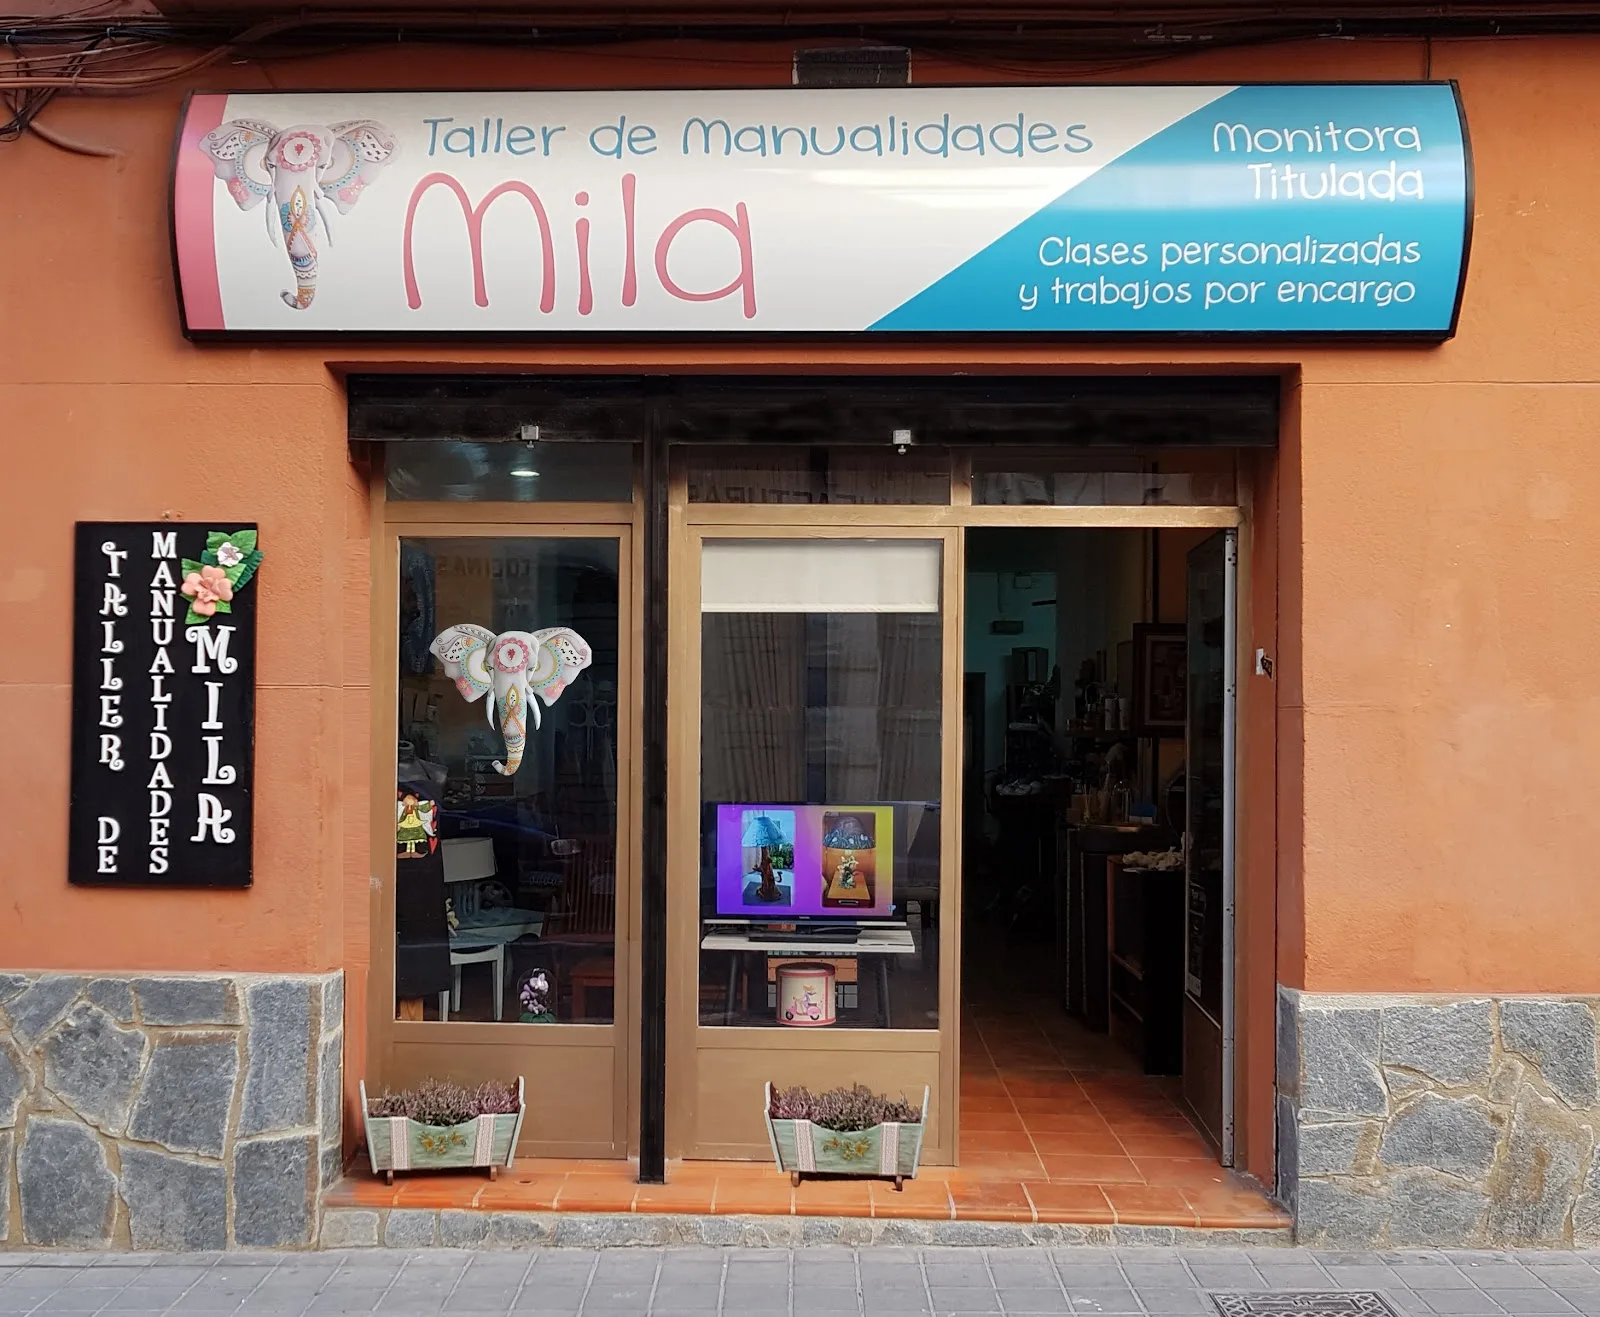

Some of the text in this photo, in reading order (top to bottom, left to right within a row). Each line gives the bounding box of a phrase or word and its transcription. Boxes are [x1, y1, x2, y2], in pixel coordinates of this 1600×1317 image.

[422, 112, 1094, 159] Taller de Manualidades
[1212, 121, 1422, 153] Monitora
[1246, 160, 1425, 202] Titulada
[402, 172, 757, 319] Mila
[1038, 232, 1422, 271] Clases personalizadas
[1018, 275, 1416, 311] y trabajos por encargo
[97, 541, 129, 874] TALLER DE
[147, 531, 178, 874] MANUALIDADES
[184, 624, 239, 844] MILA
